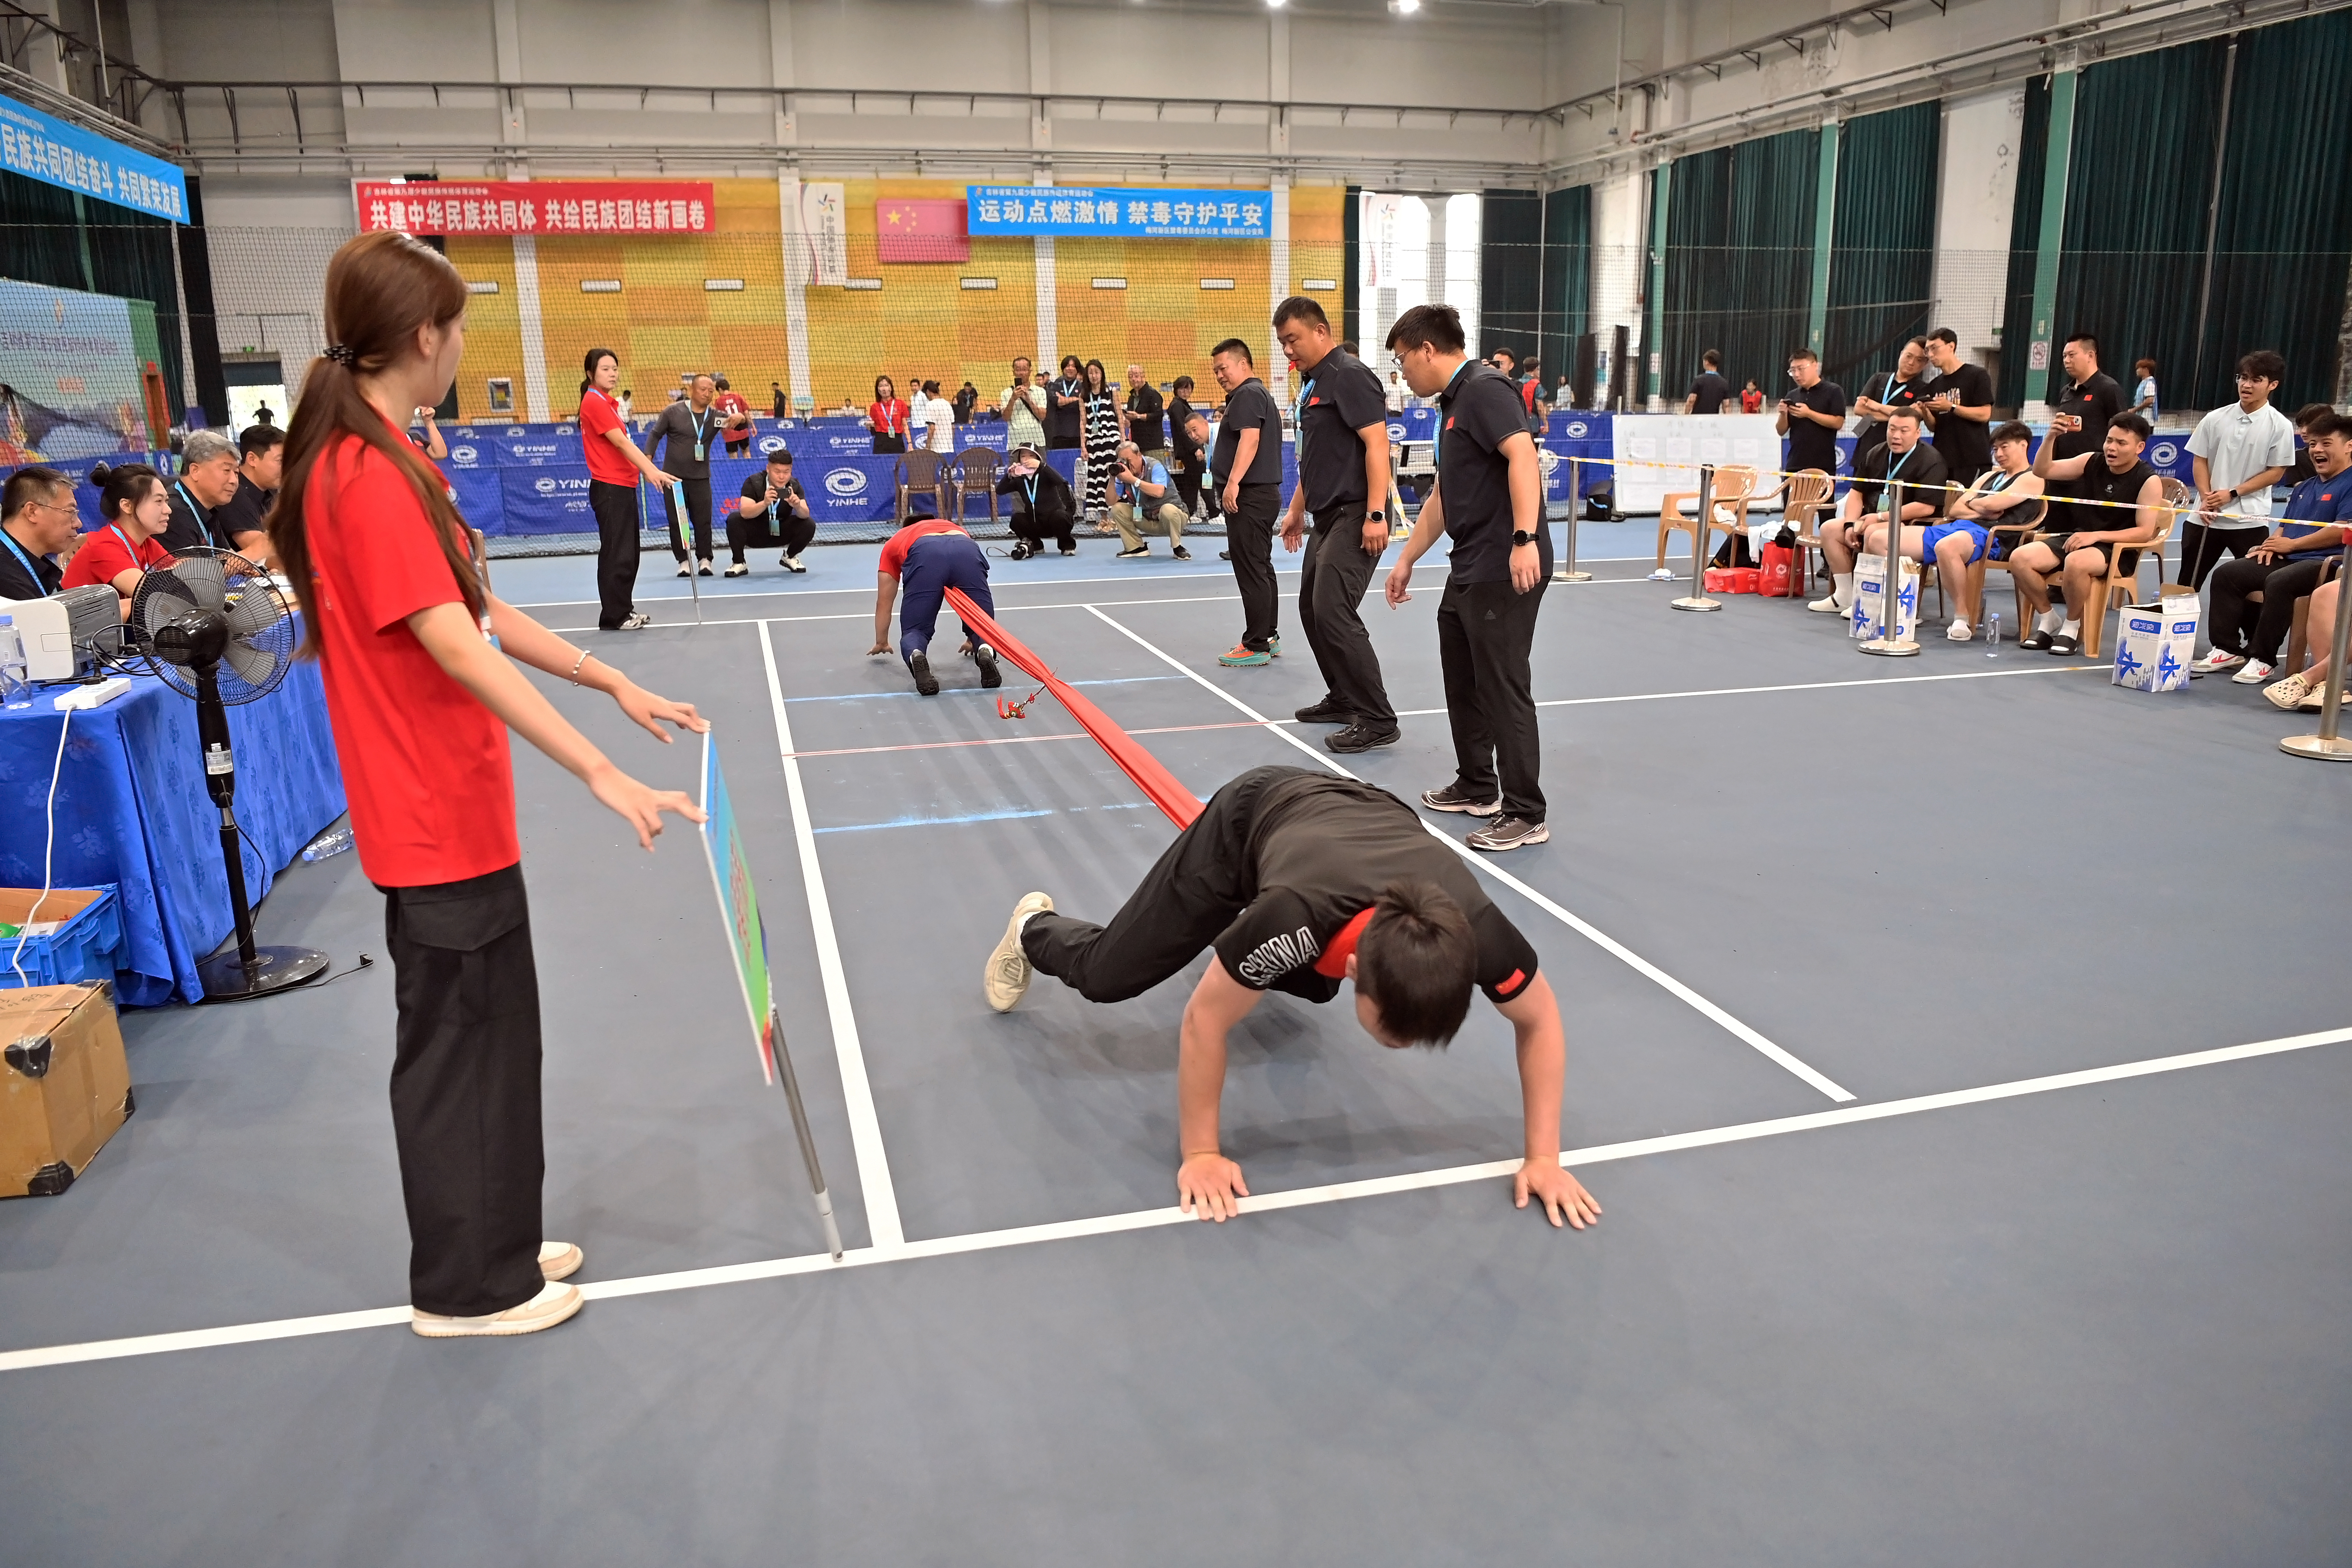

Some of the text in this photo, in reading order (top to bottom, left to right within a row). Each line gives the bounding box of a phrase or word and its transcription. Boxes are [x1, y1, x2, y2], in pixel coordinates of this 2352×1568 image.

[0, 123, 182, 218] 民族共同团结奋斗 共同繁荣发展
[370, 198, 705, 231] 共建中华民族共同体 共绘民族团结新画卷
[978, 199, 1263, 226] 运动点燃激情 禁毒守护平安
[827, 498, 868, 507] YINHE
[2116, 637, 2143, 681] 水
[2159, 642, 2181, 686] 水
[1239, 926, 1321, 986] CHINA
